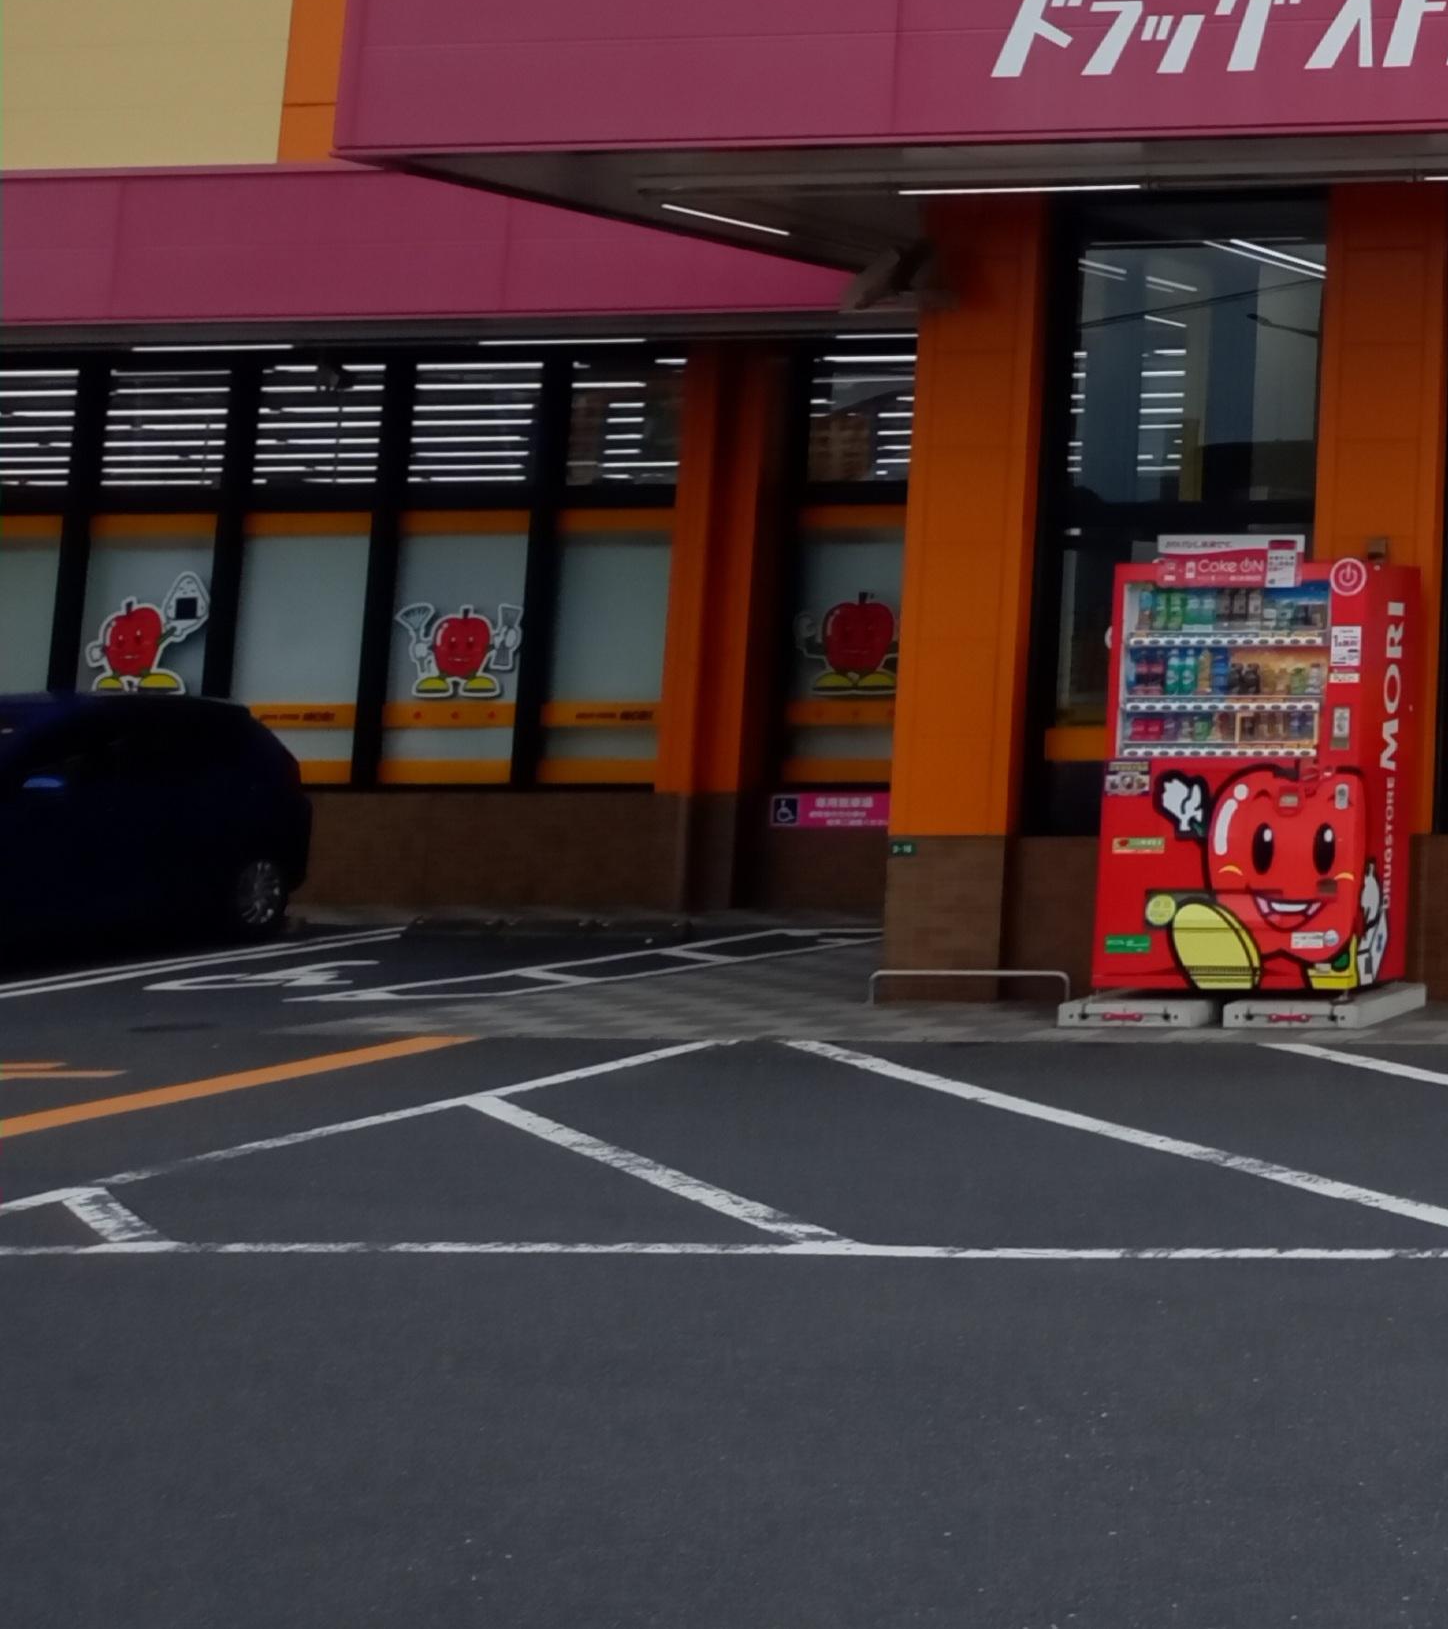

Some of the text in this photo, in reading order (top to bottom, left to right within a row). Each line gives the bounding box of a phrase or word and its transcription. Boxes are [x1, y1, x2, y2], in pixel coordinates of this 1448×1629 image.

[1199, 558, 1237, 573] Coke
[1380, 601, 1405, 910] DRUGSTORE MORI
